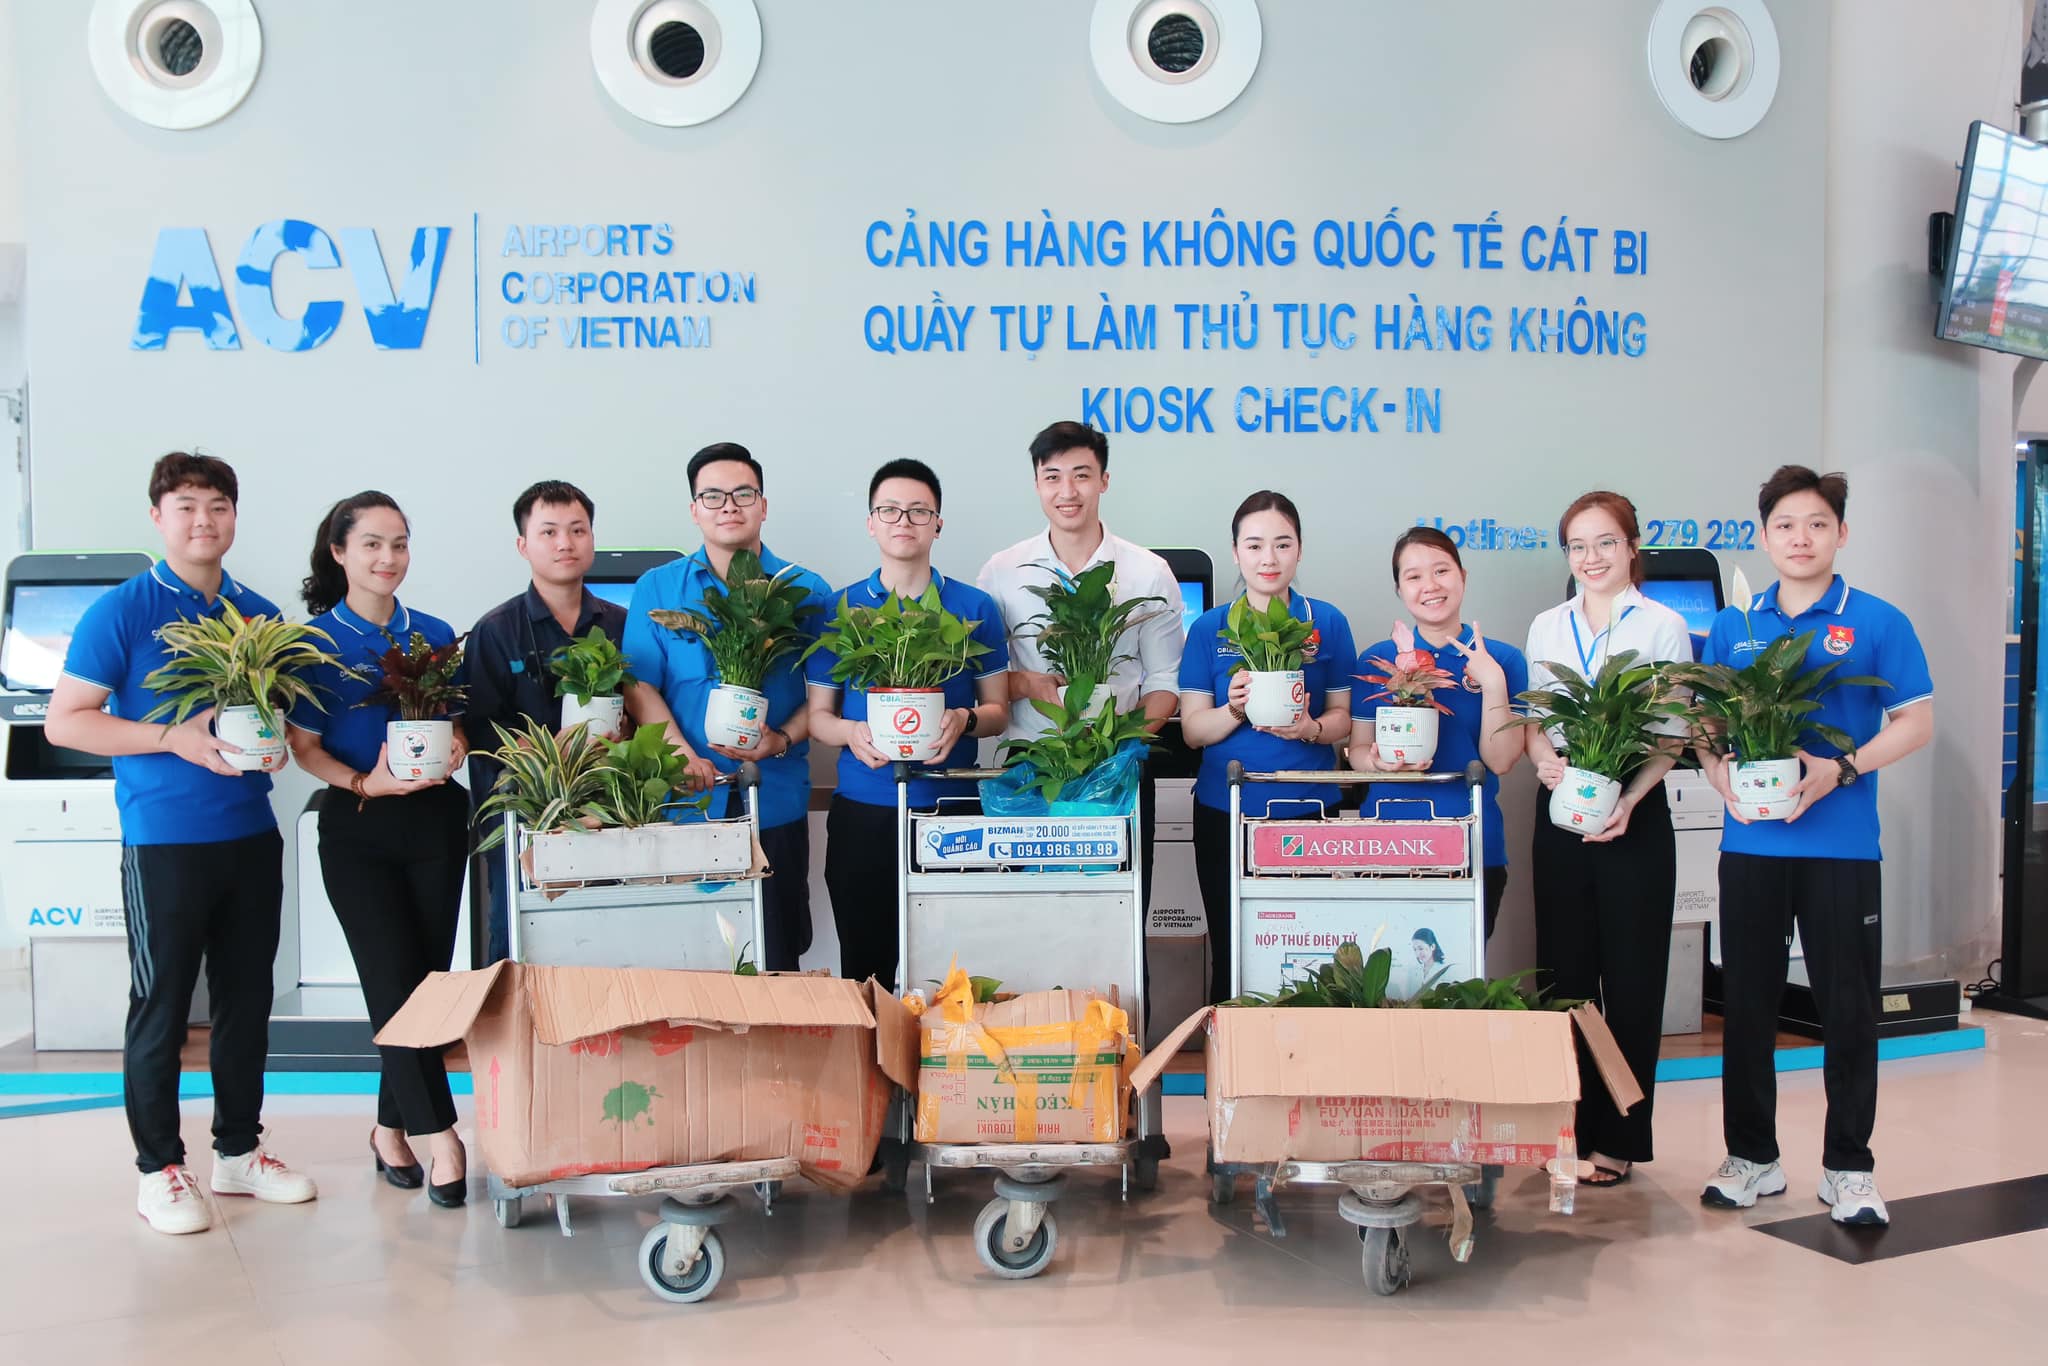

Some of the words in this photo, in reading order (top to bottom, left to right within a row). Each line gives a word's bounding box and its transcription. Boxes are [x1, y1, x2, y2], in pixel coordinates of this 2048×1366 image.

[501, 223, 674, 256] AIRPORTS
[865, 208, 989, 268] CẢNG
[1005, 209, 1127, 267] HÀNG
[1142, 207, 1297, 267] KHÔNG
[1313, 206, 1436, 269] QUỐC
[1453, 210, 1504, 269] TẾ
[1521, 215, 1599, 273] CÁT
[1613, 229, 1648, 275] BI
[129, 218, 452, 352] ACV
[501, 270, 756, 304] CORPORATION
[501, 315, 549, 349] OF
[558, 315, 711, 349] VIETNAM
[864, 290, 976, 355] QUẦY
[990, 304, 1053, 361] TỰ
[1066, 292, 1157, 351] LÀM
[1174, 290, 1259, 351] THỦ
[1273, 302, 1358, 359] TỤC
[1375, 293, 1494, 352] HÀNG
[1509, 296, 1648, 358] KHÔNG
[1081, 386, 1215, 434] KIOSK
[1646, 519, 1699, 547] 279
[1705, 519, 1756, 550] 292
[1036, 825, 1070, 838] 20.000
[1307, 839, 1437, 856] AGRIBANK
[1017, 843, 1113, 857] 094.986.98.98
[28, 907, 83, 926] ACV
[1255, 931, 1279, 949] NỘP
[1281, 931, 1311, 947] THUẾ
[1313, 931, 1340, 950] ĐIỆN
[1319, 1106, 1338, 1118] FU
[1343, 1106, 1385, 1118] YUAN
[1423, 1106, 1450, 1118] HUI
